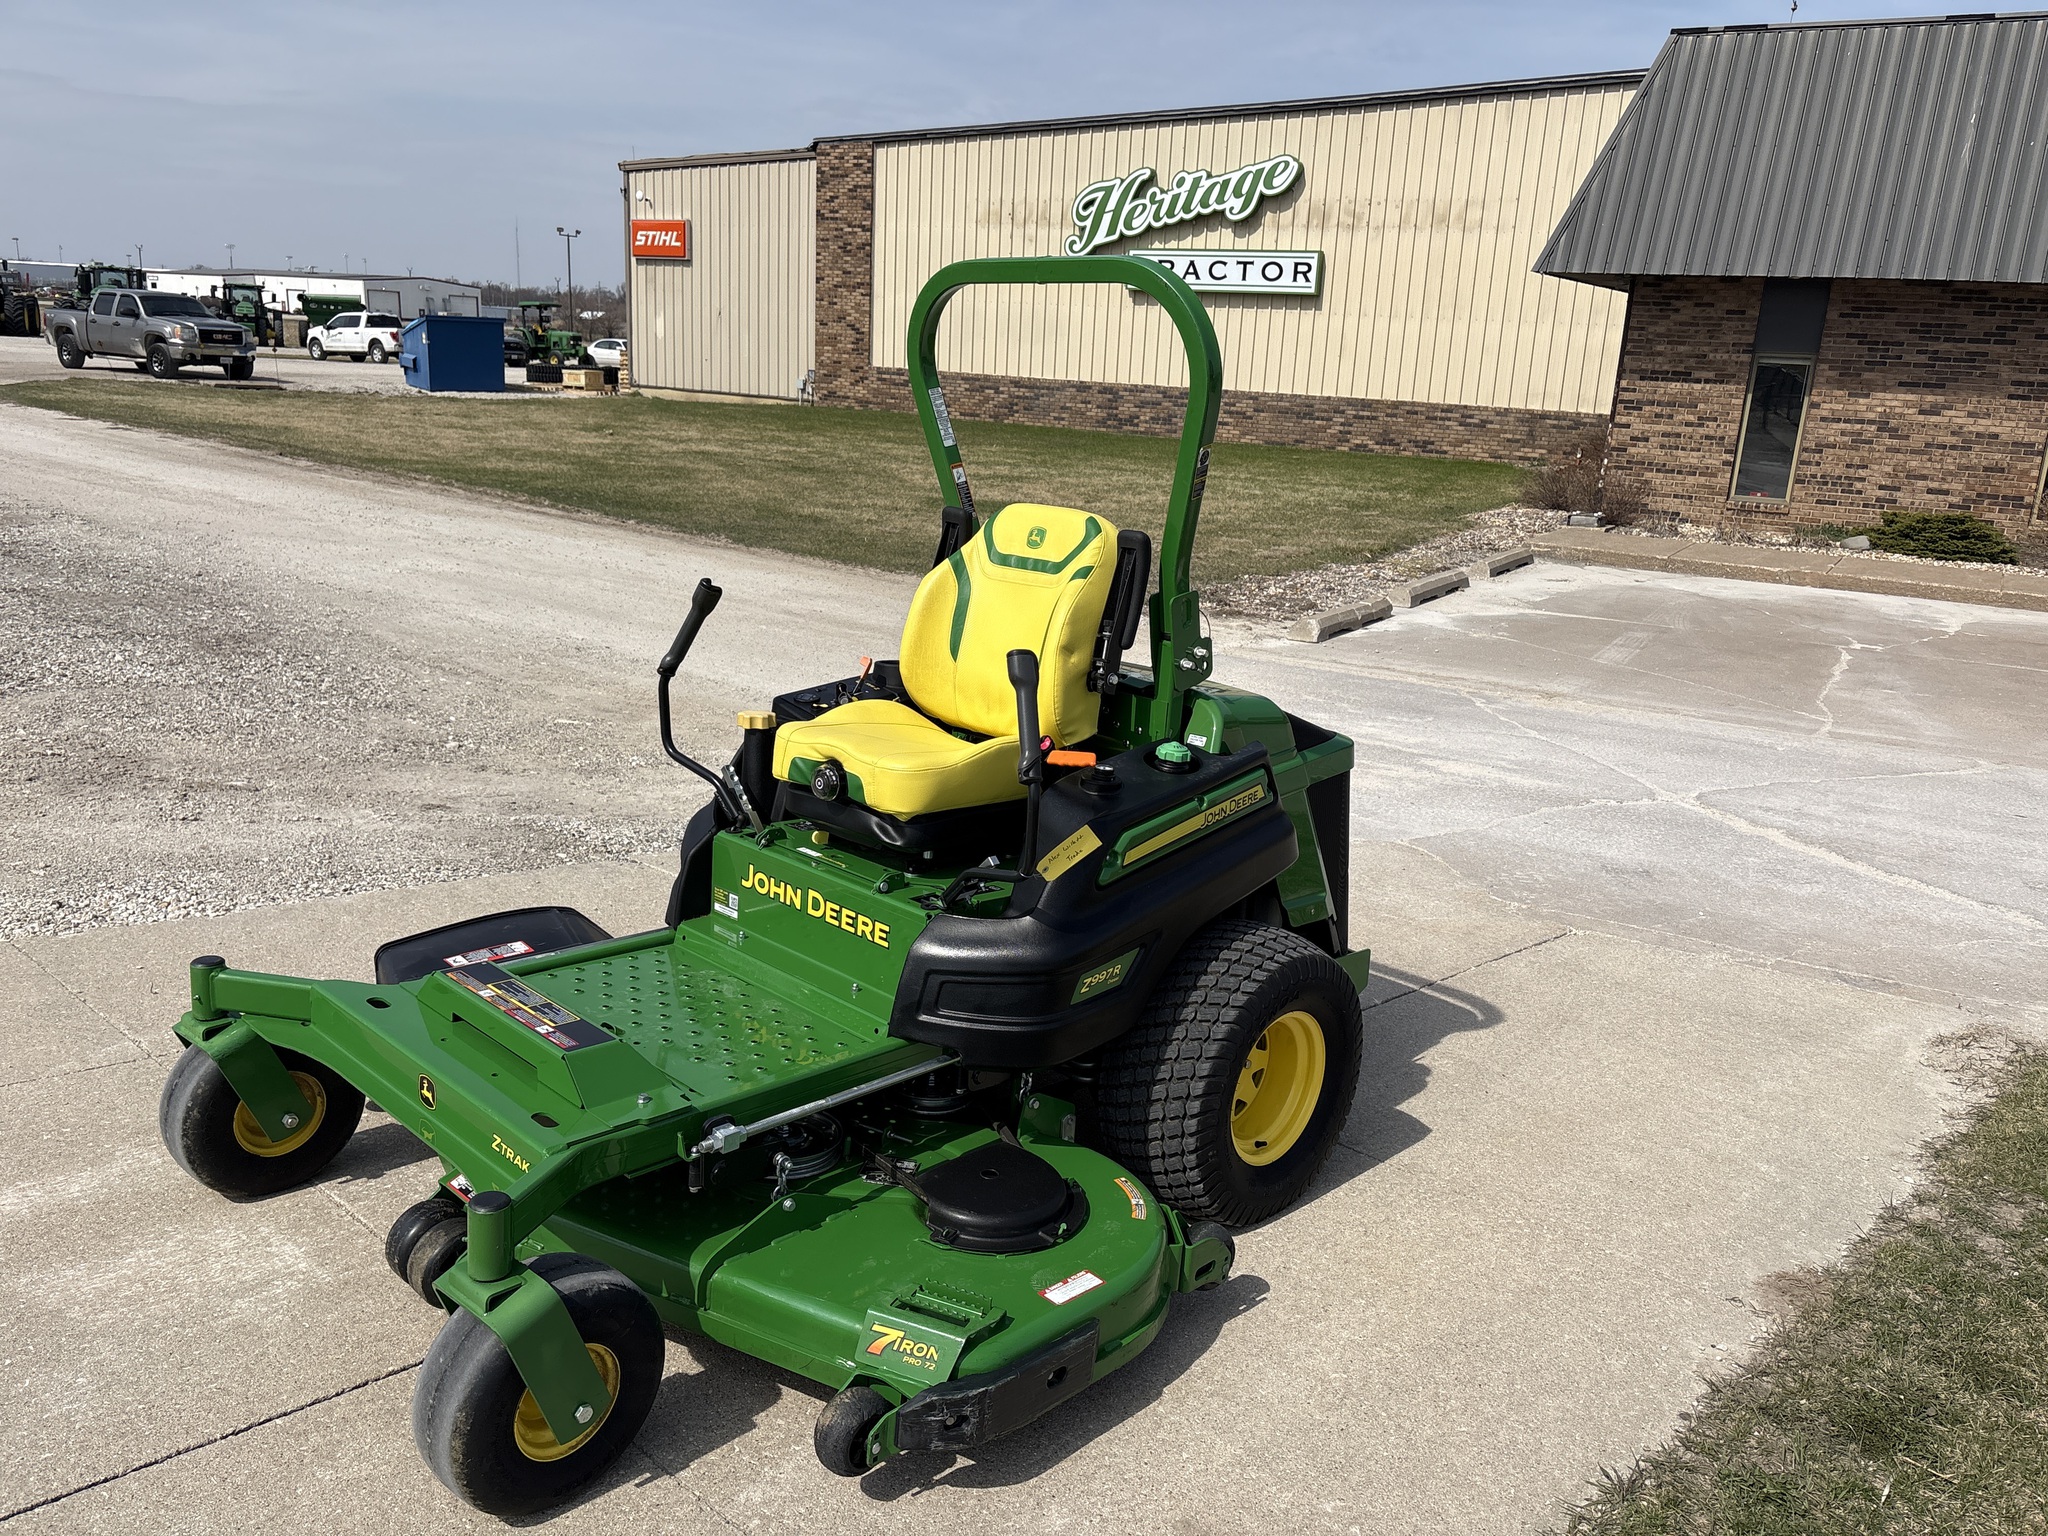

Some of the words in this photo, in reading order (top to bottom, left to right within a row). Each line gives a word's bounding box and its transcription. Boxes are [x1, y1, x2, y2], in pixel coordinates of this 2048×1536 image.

[1066, 157, 1296, 254] Heritage
[635, 231, 682, 247] STIHL
[1157, 259, 1312, 283] ACTOR
[1200, 805, 1228, 829] JOHN
[1229, 790, 1260, 814] DEERE
[741, 863, 802, 911] JOHN
[806, 888, 890, 949] DEERE
[1080, 964, 1122, 993] Z997R
[491, 1133, 531, 1174] ZTRAK
[902, 1355, 922, 1367] PRO
[923, 1361, 936, 1371] 72
